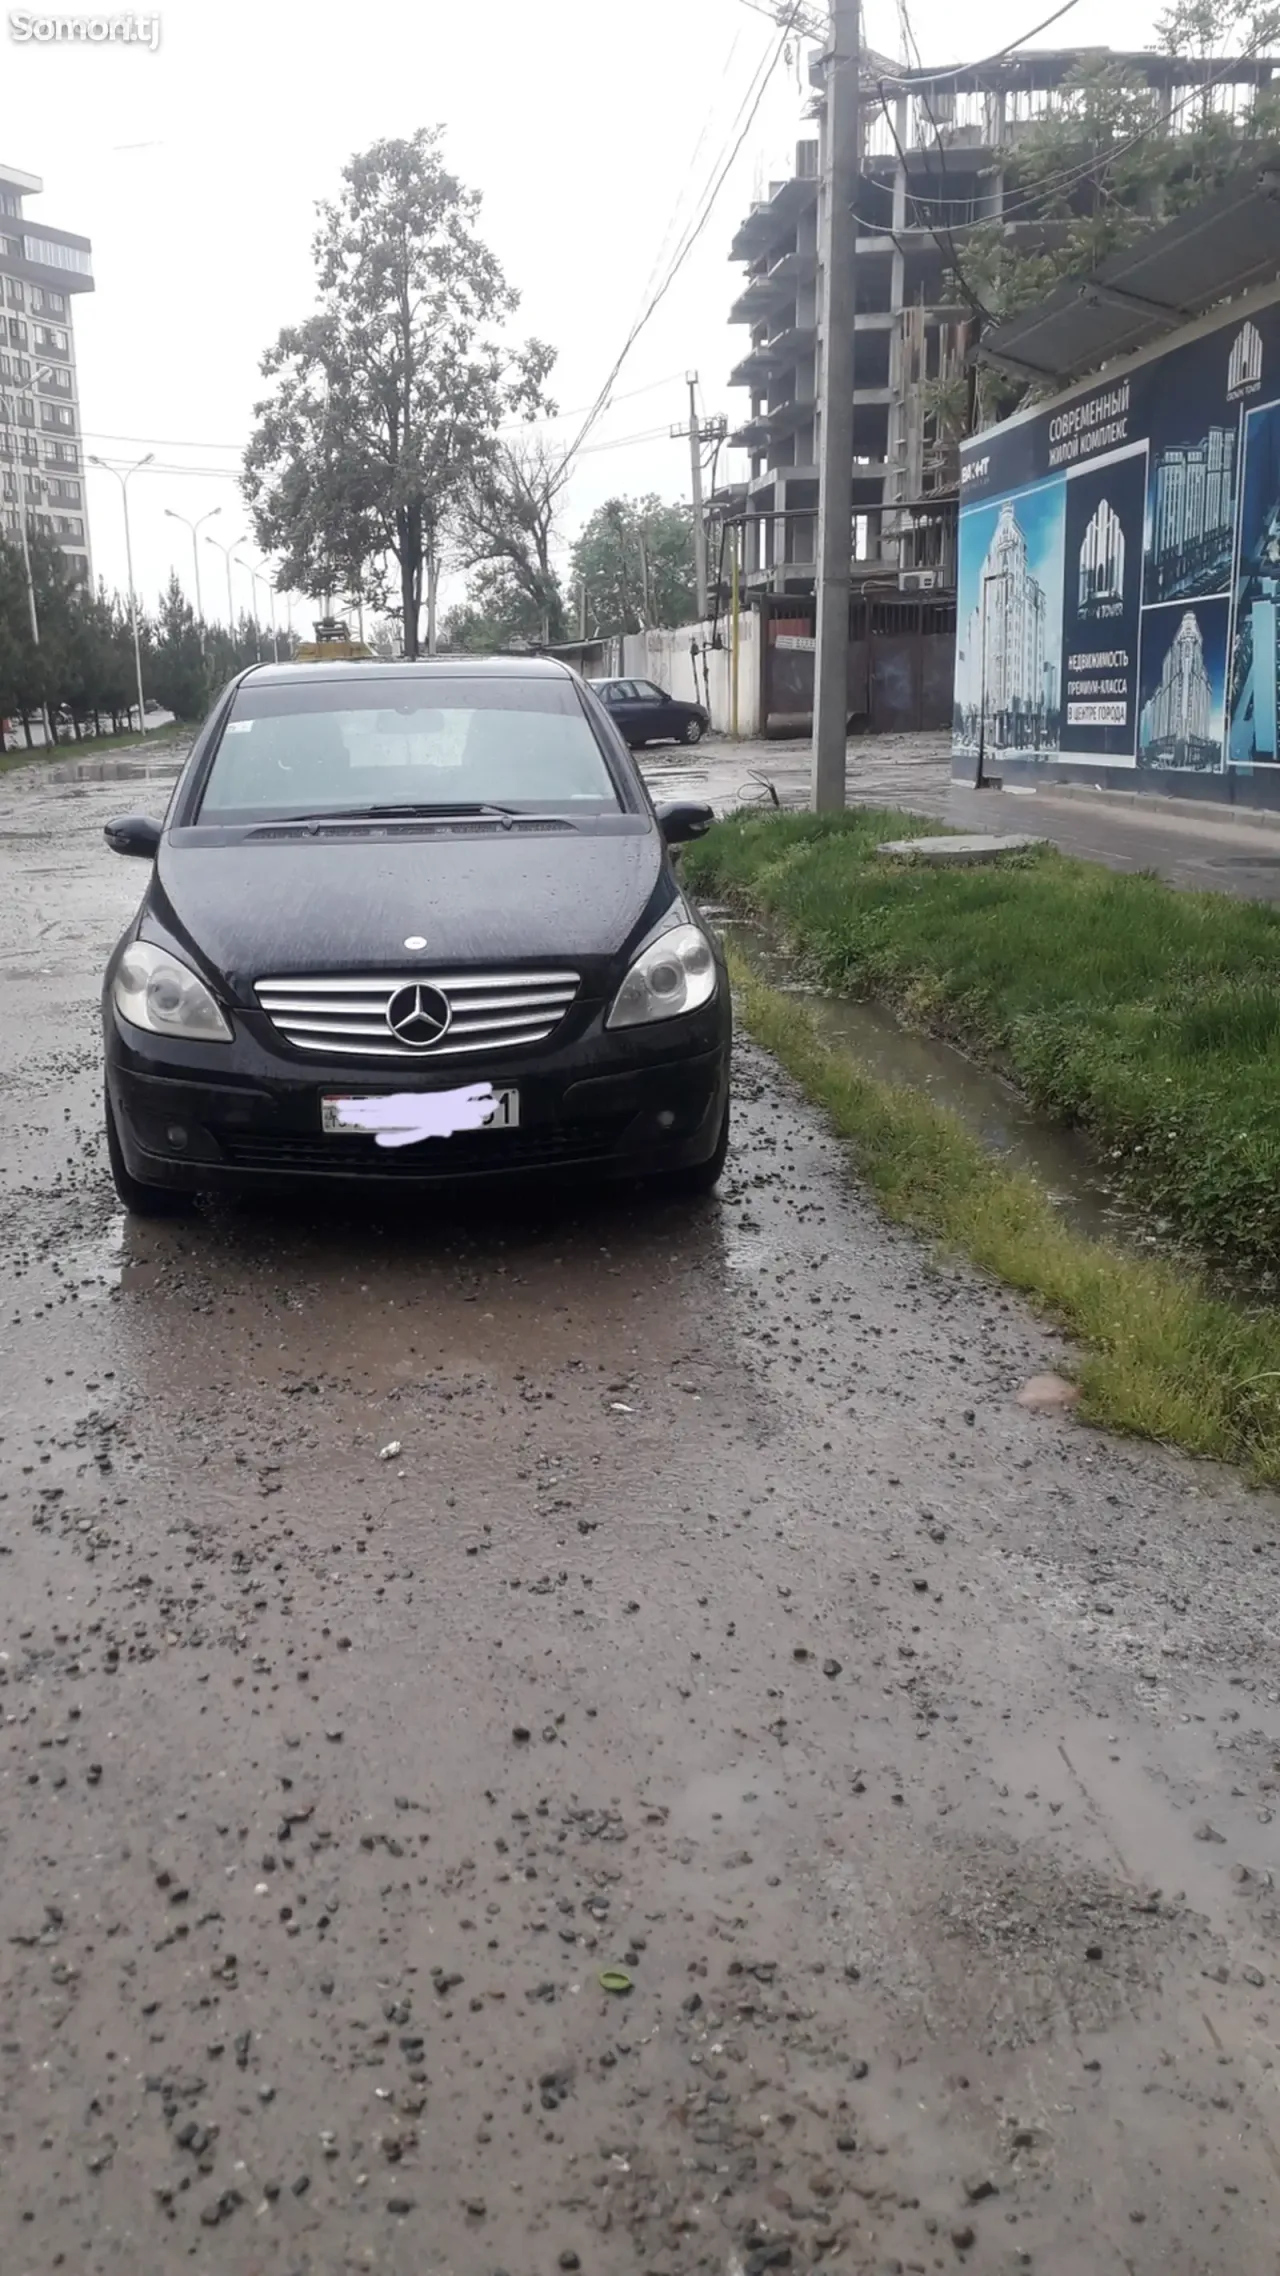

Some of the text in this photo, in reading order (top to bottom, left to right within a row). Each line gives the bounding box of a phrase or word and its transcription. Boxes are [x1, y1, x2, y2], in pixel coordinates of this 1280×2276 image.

[1049, 378, 1130, 443] СОВРЕМЕННЫЙ
[1048, 417, 1128, 468] ЖИЛОЙ КОМПЛЕКС
[1067, 649, 1129, 672] НЕДВИЖИМОСТЬ
[1067, 678, 1127, 695] ПРЕМИУМ-КЛАССА
[1074, 706, 1097, 722] ЦЕНТРЕ
[1098, 705, 1125, 723] ГОРОДА
